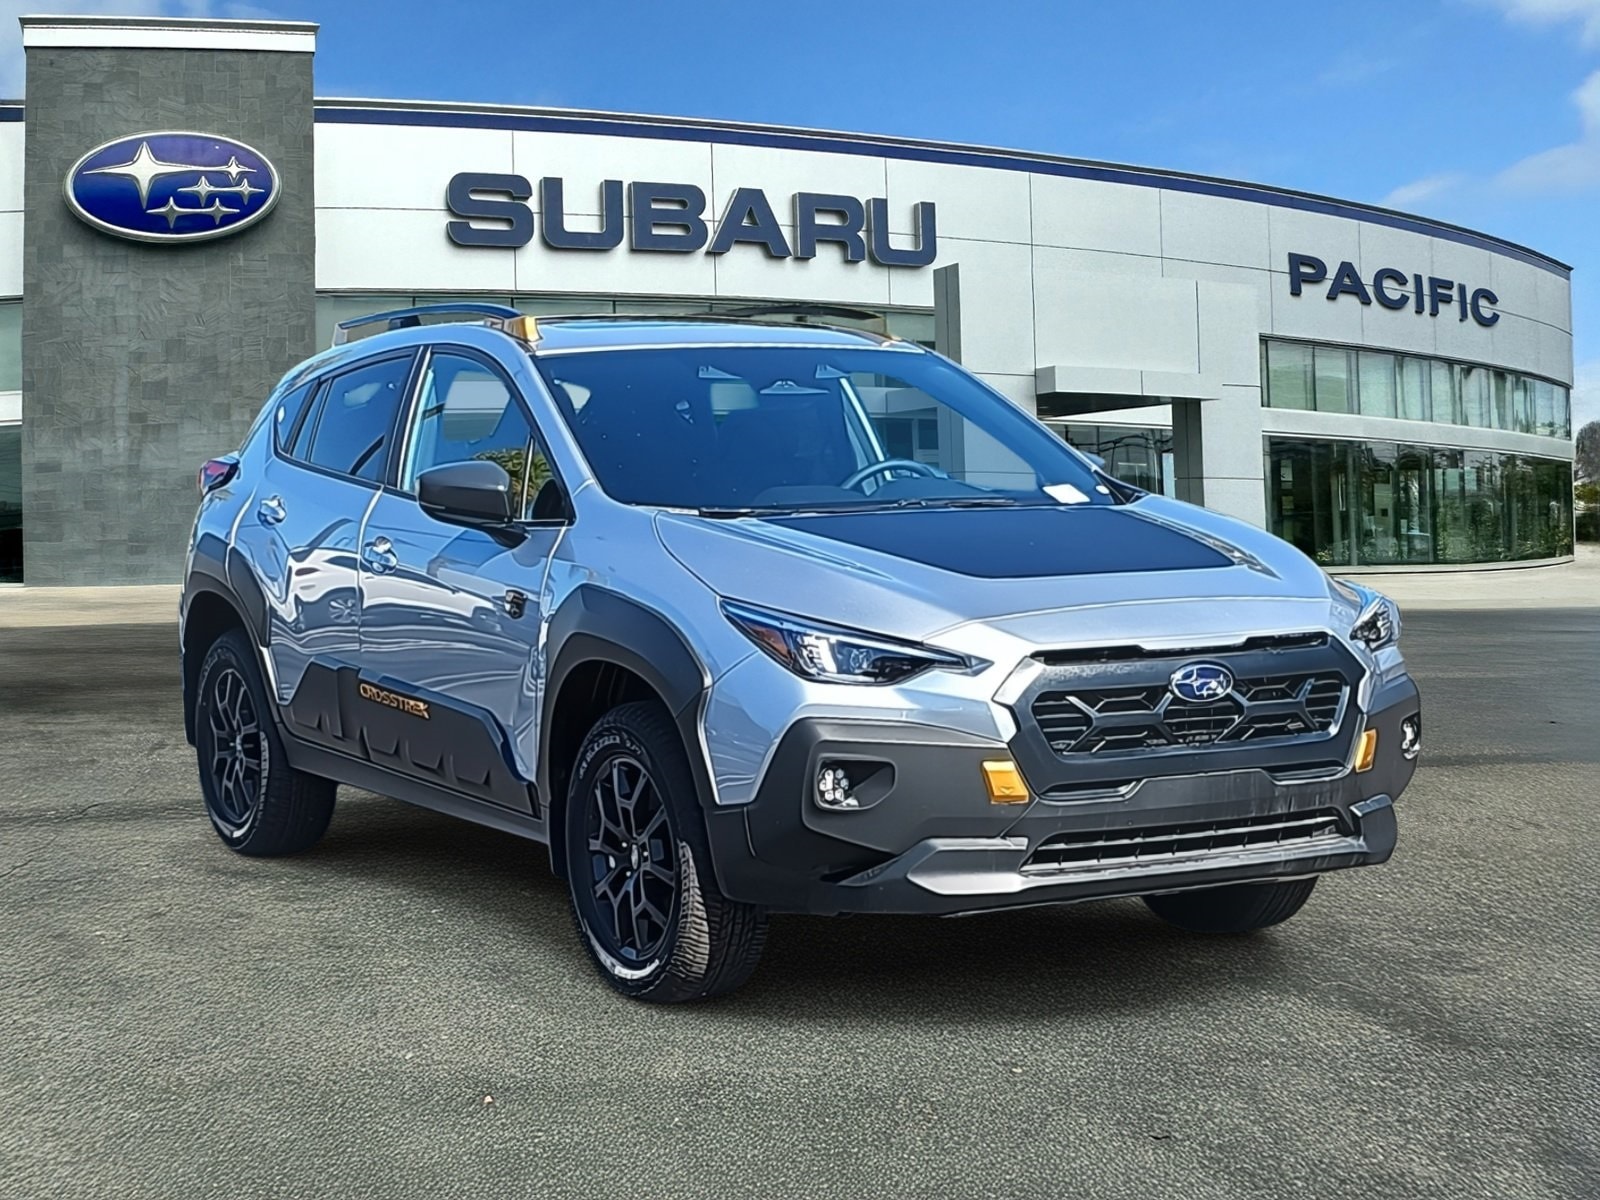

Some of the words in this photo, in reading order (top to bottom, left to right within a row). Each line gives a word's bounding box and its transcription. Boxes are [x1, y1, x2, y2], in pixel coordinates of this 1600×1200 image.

[446, 172, 937, 268] SUBARU
[1288, 252, 1501, 327] PACIFIC
[360, 683, 430, 719] CROSSTREK
